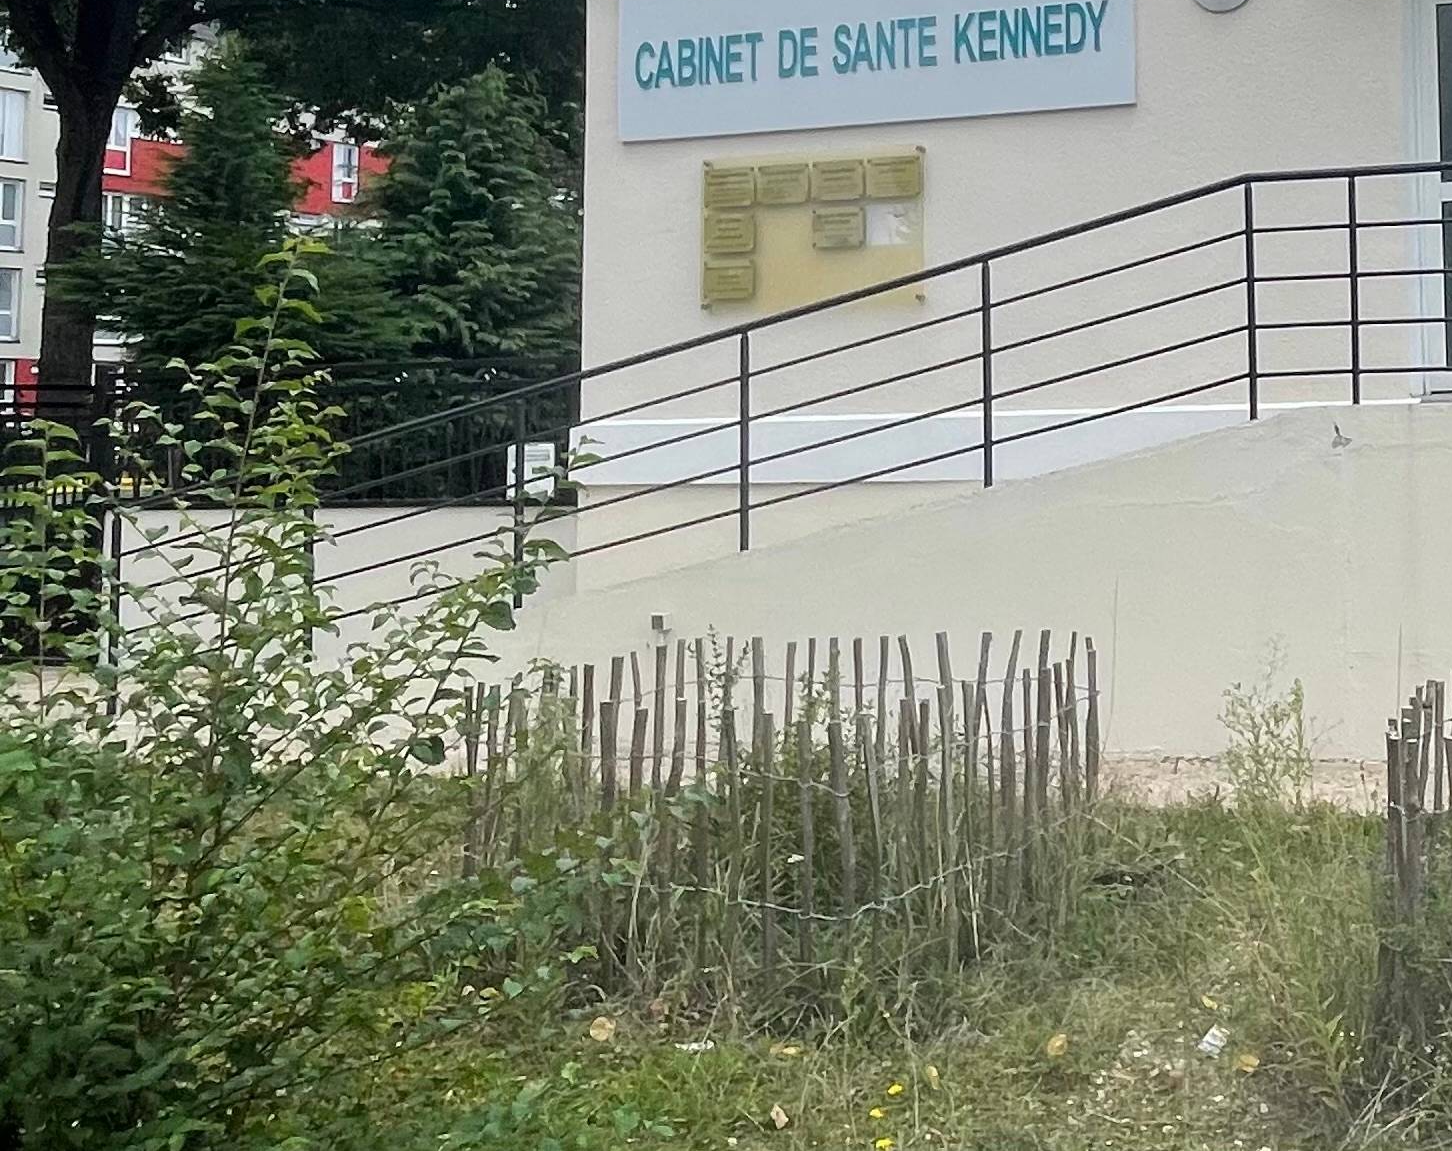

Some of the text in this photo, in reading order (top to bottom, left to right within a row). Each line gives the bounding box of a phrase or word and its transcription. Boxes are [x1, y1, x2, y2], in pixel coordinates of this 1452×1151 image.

[635, 0, 1109, 90] CABINET DE SANTE KENNEDY
